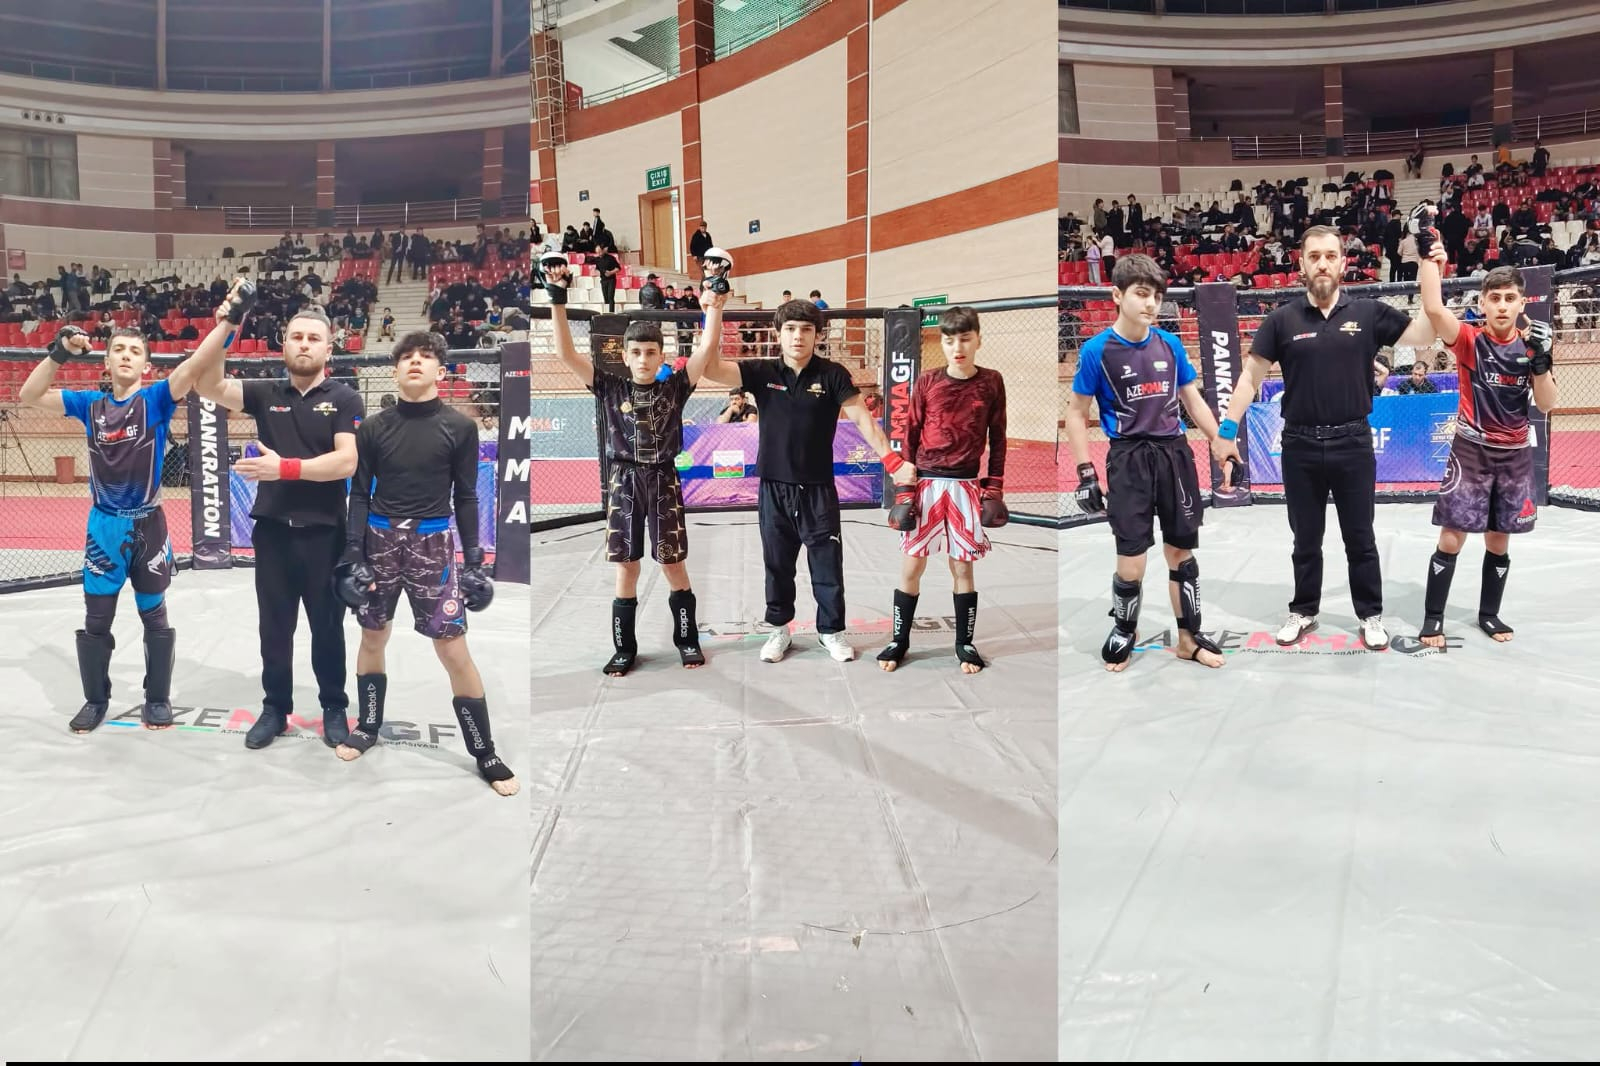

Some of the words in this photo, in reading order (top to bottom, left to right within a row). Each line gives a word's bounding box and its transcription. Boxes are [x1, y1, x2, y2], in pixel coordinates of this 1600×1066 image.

[651, 178, 666, 187] EXIT
[680, 607, 689, 638] adidas
[366, 690, 377, 725] Reebok
[353, 729, 370, 741] UFC
[462, 715, 486, 751] Reebok
